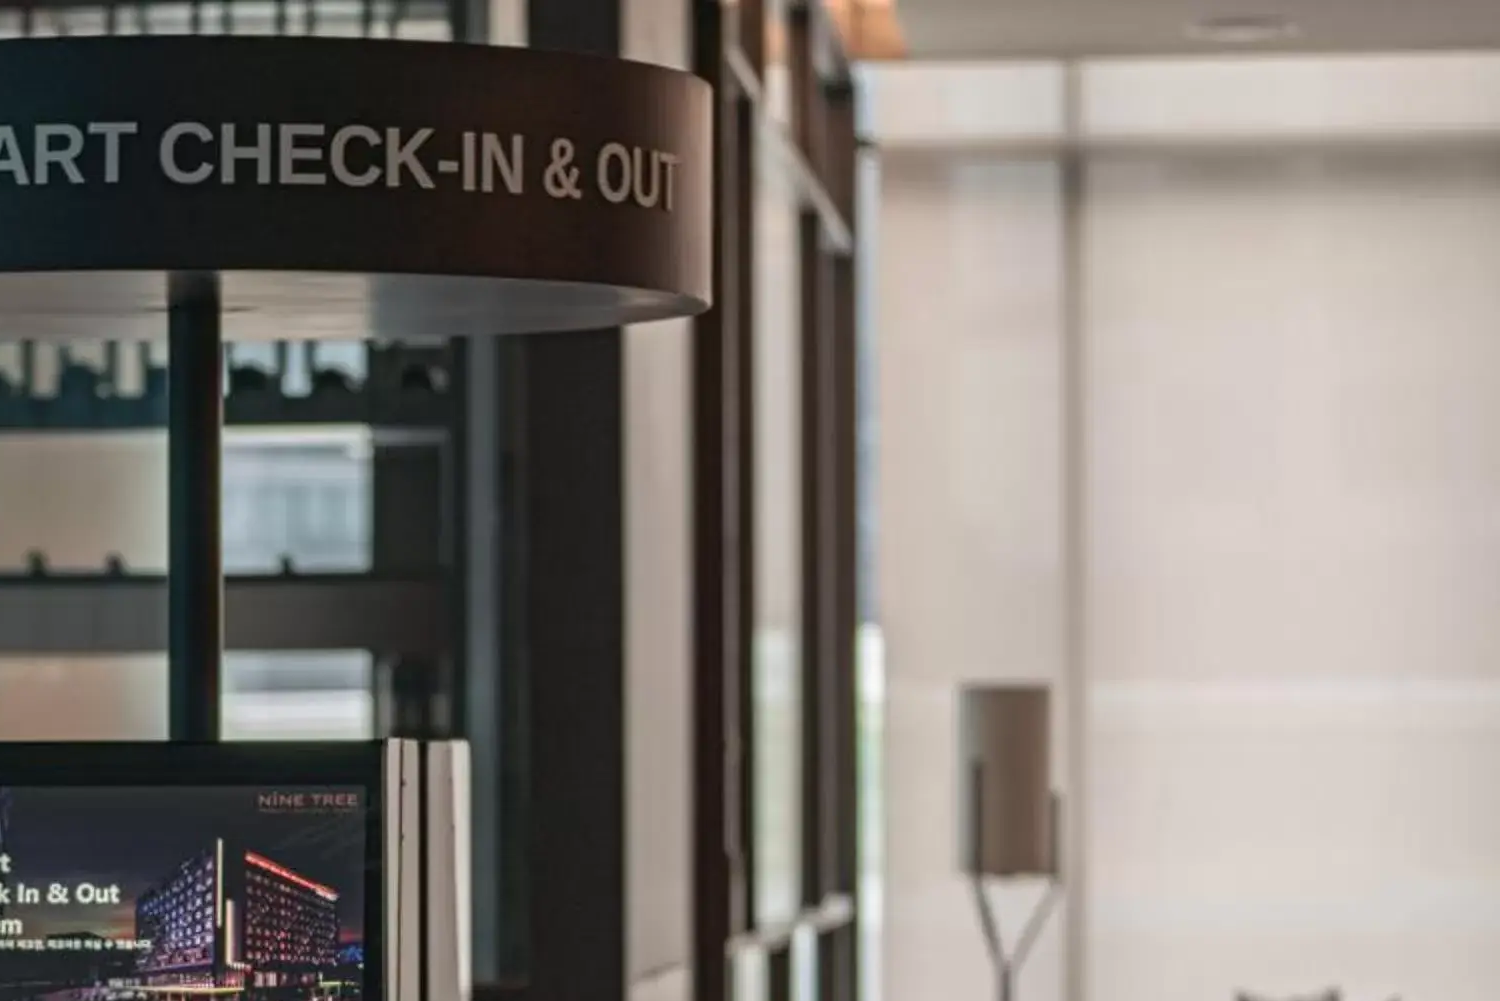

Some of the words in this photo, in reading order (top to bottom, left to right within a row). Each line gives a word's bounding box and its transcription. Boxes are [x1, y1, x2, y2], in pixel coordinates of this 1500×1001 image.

[158, 121, 524, 195] CHECK-IN
[543, 137, 582, 200] &
[596, 142, 683, 212] OUT
[312, 793, 358, 807] TREE
[17, 883, 39, 904] In
[46, 882, 69, 904] &
[75, 882, 120, 904] Out
